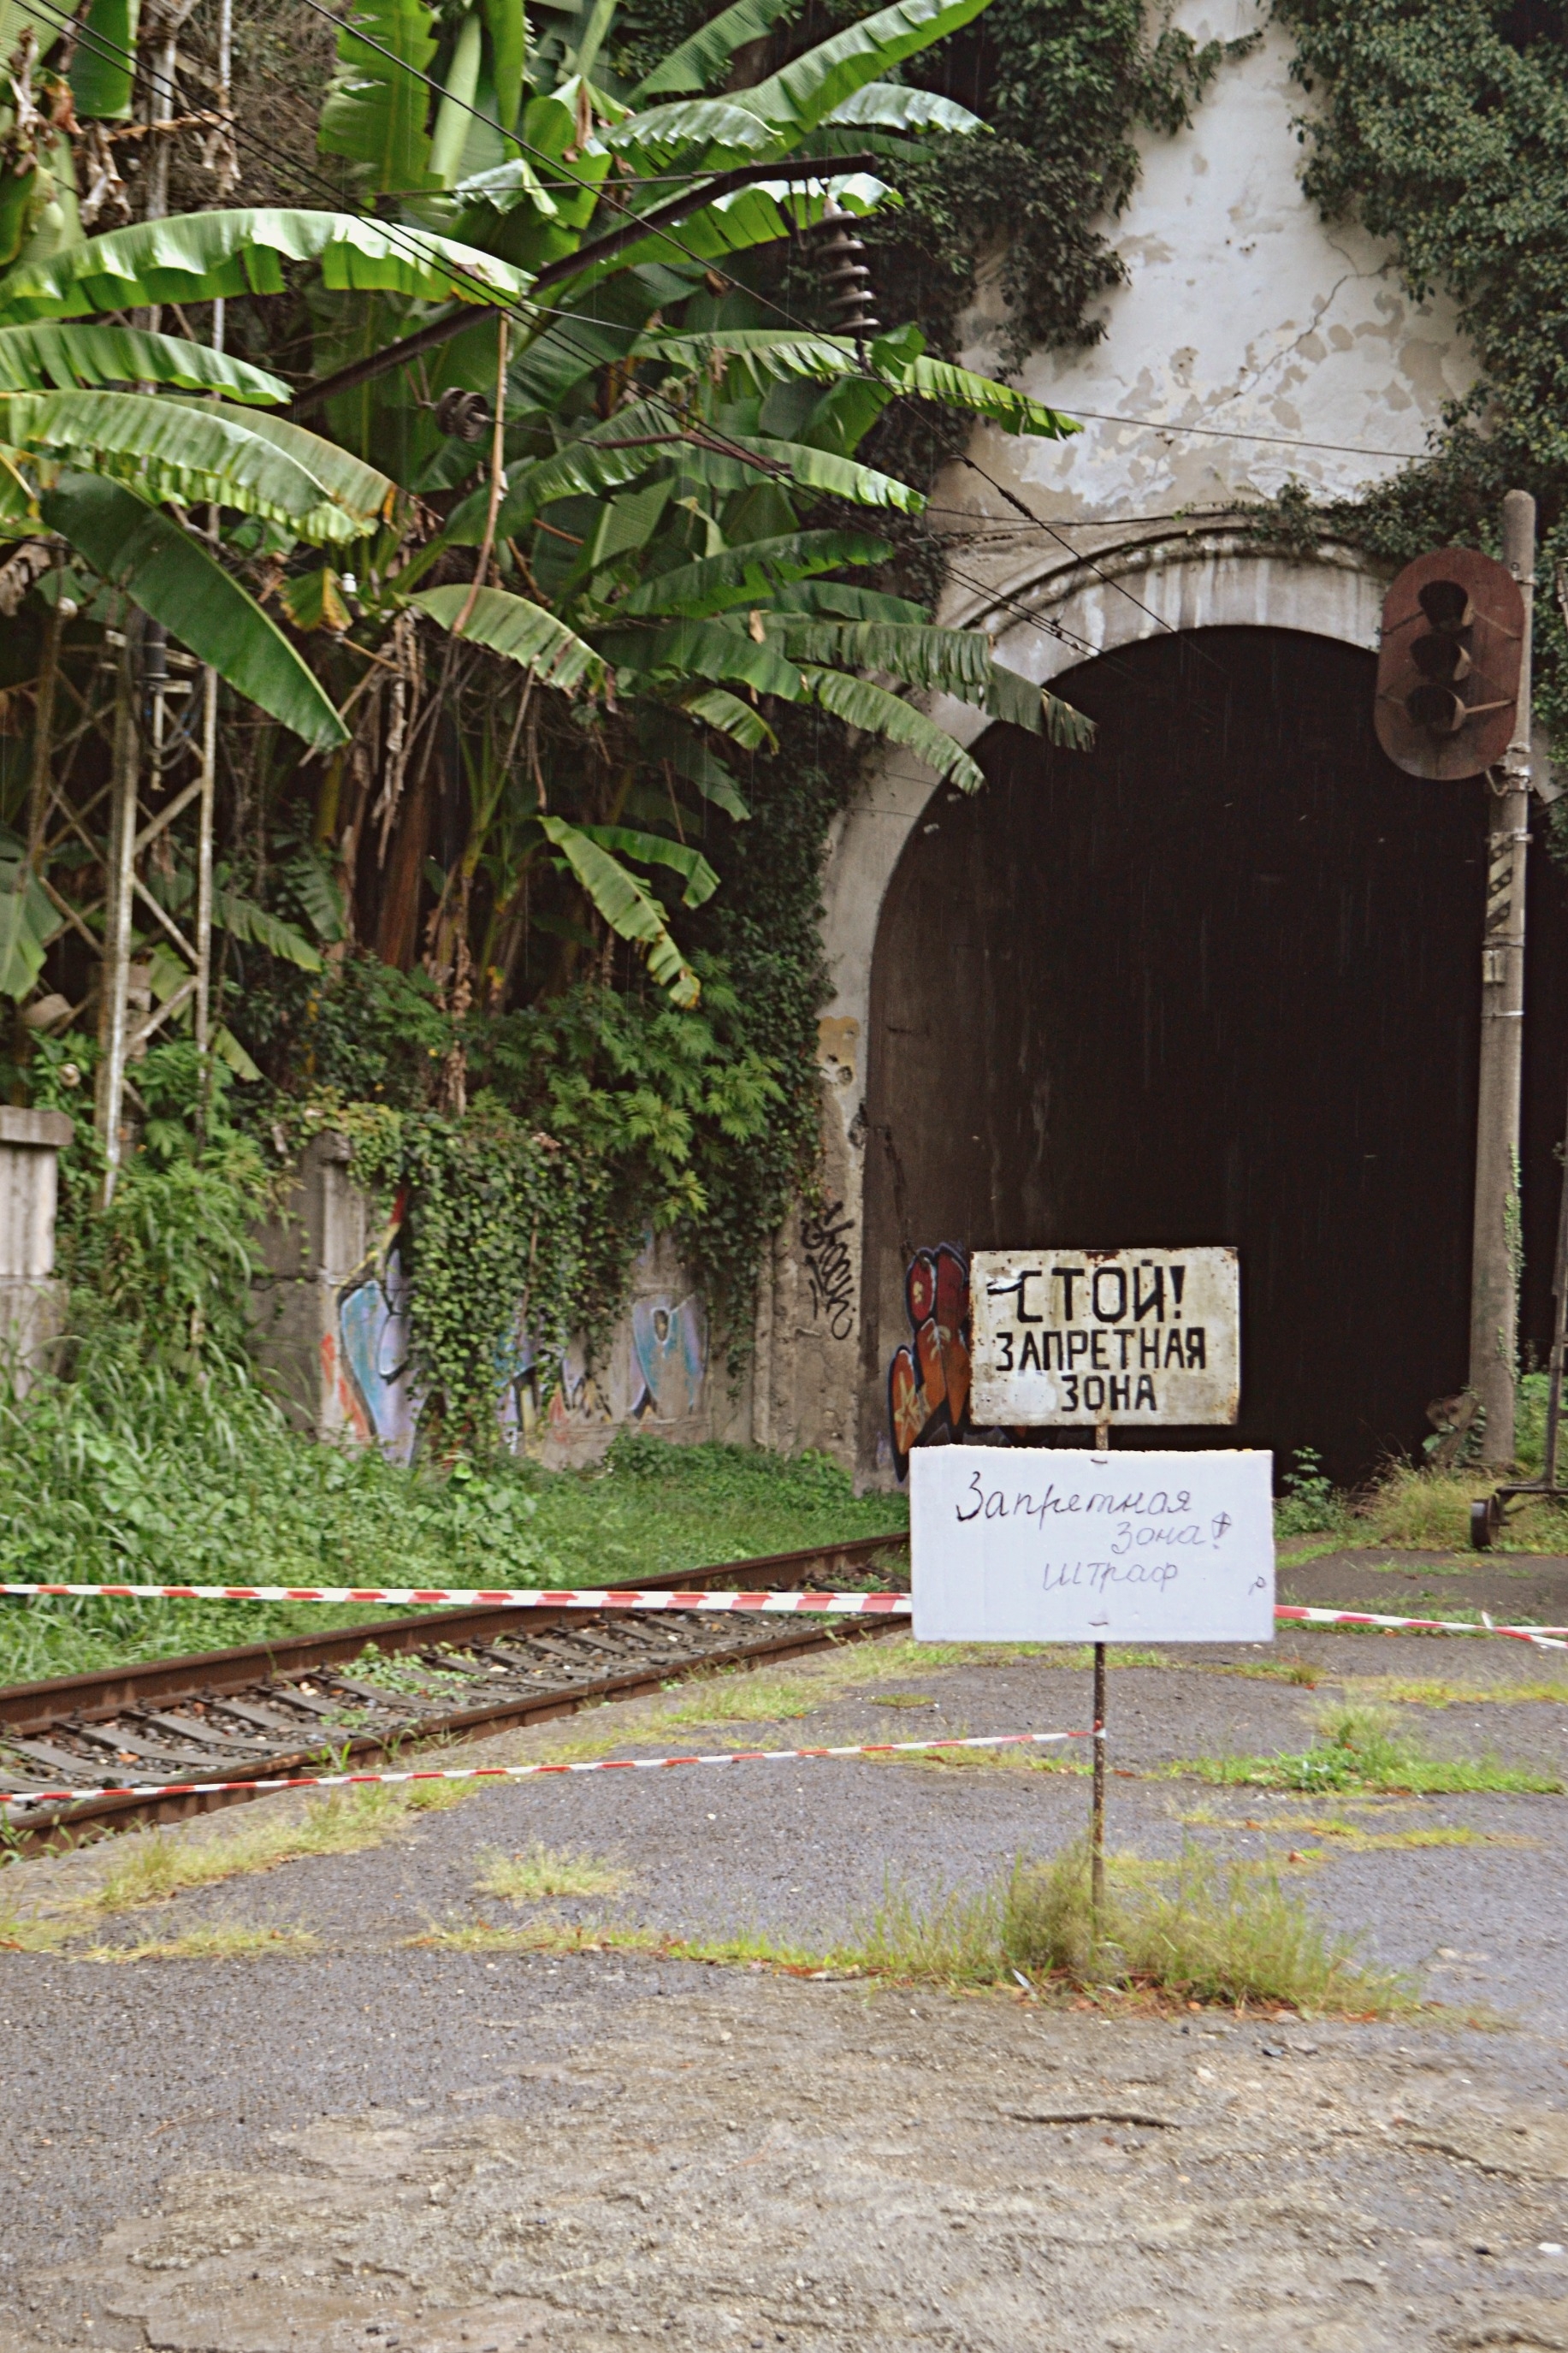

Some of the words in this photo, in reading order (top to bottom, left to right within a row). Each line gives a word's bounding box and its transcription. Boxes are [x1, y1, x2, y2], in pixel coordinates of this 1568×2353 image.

[1017, 1259, 1186, 1323] СТОЙ!
[996, 1327, 1206, 1371] ЗАПРЕТНАЯ
[1062, 1374, 1157, 1412] ЗОНА
[956, 1471, 1191, 1530] Запретная
